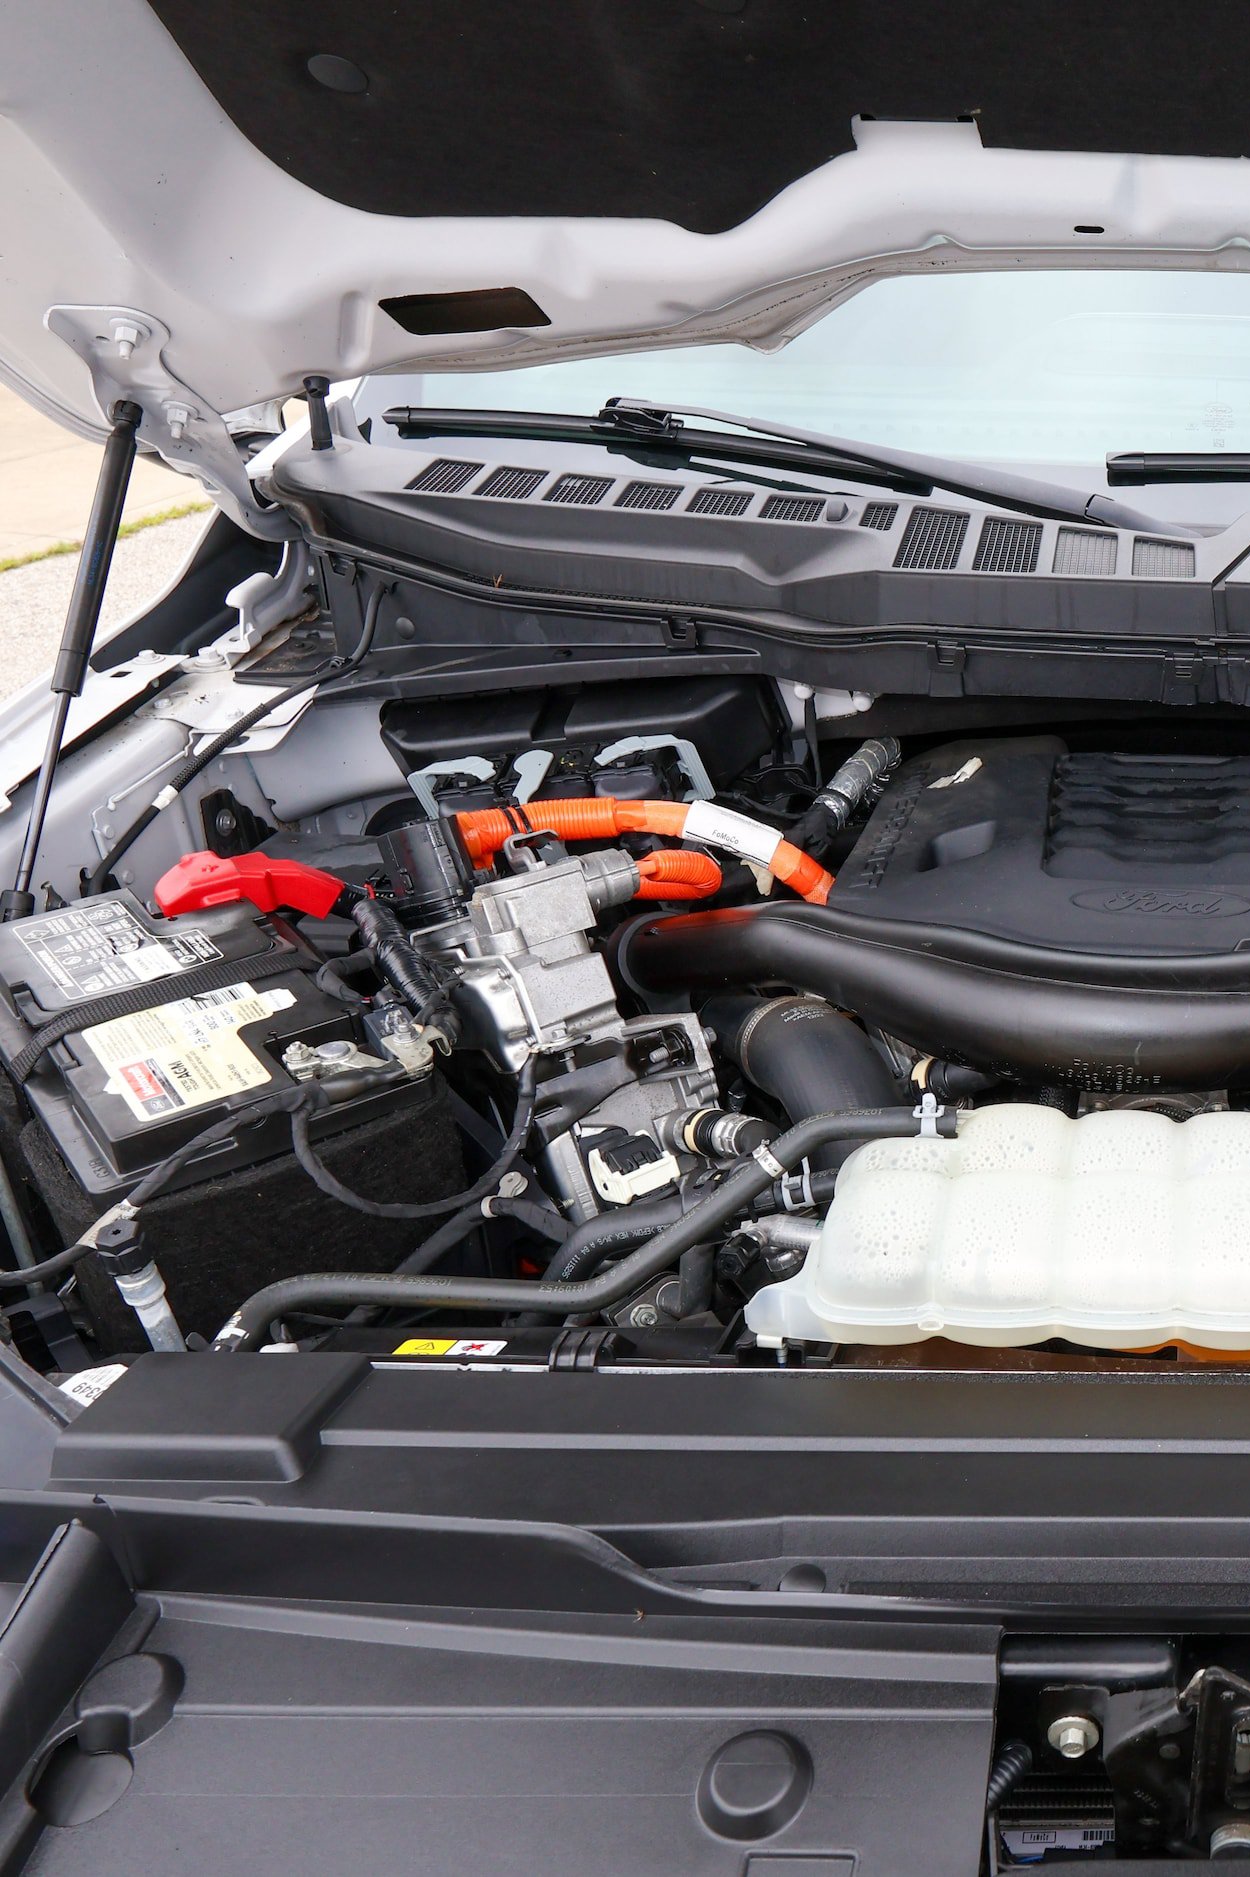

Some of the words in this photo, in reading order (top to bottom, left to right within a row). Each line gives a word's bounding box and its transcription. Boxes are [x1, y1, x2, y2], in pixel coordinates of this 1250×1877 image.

[711, 829, 739, 845] FoMoCo
[1102, 889, 1223, 915] Ford
[168, 1060, 192, 1079] AGM
